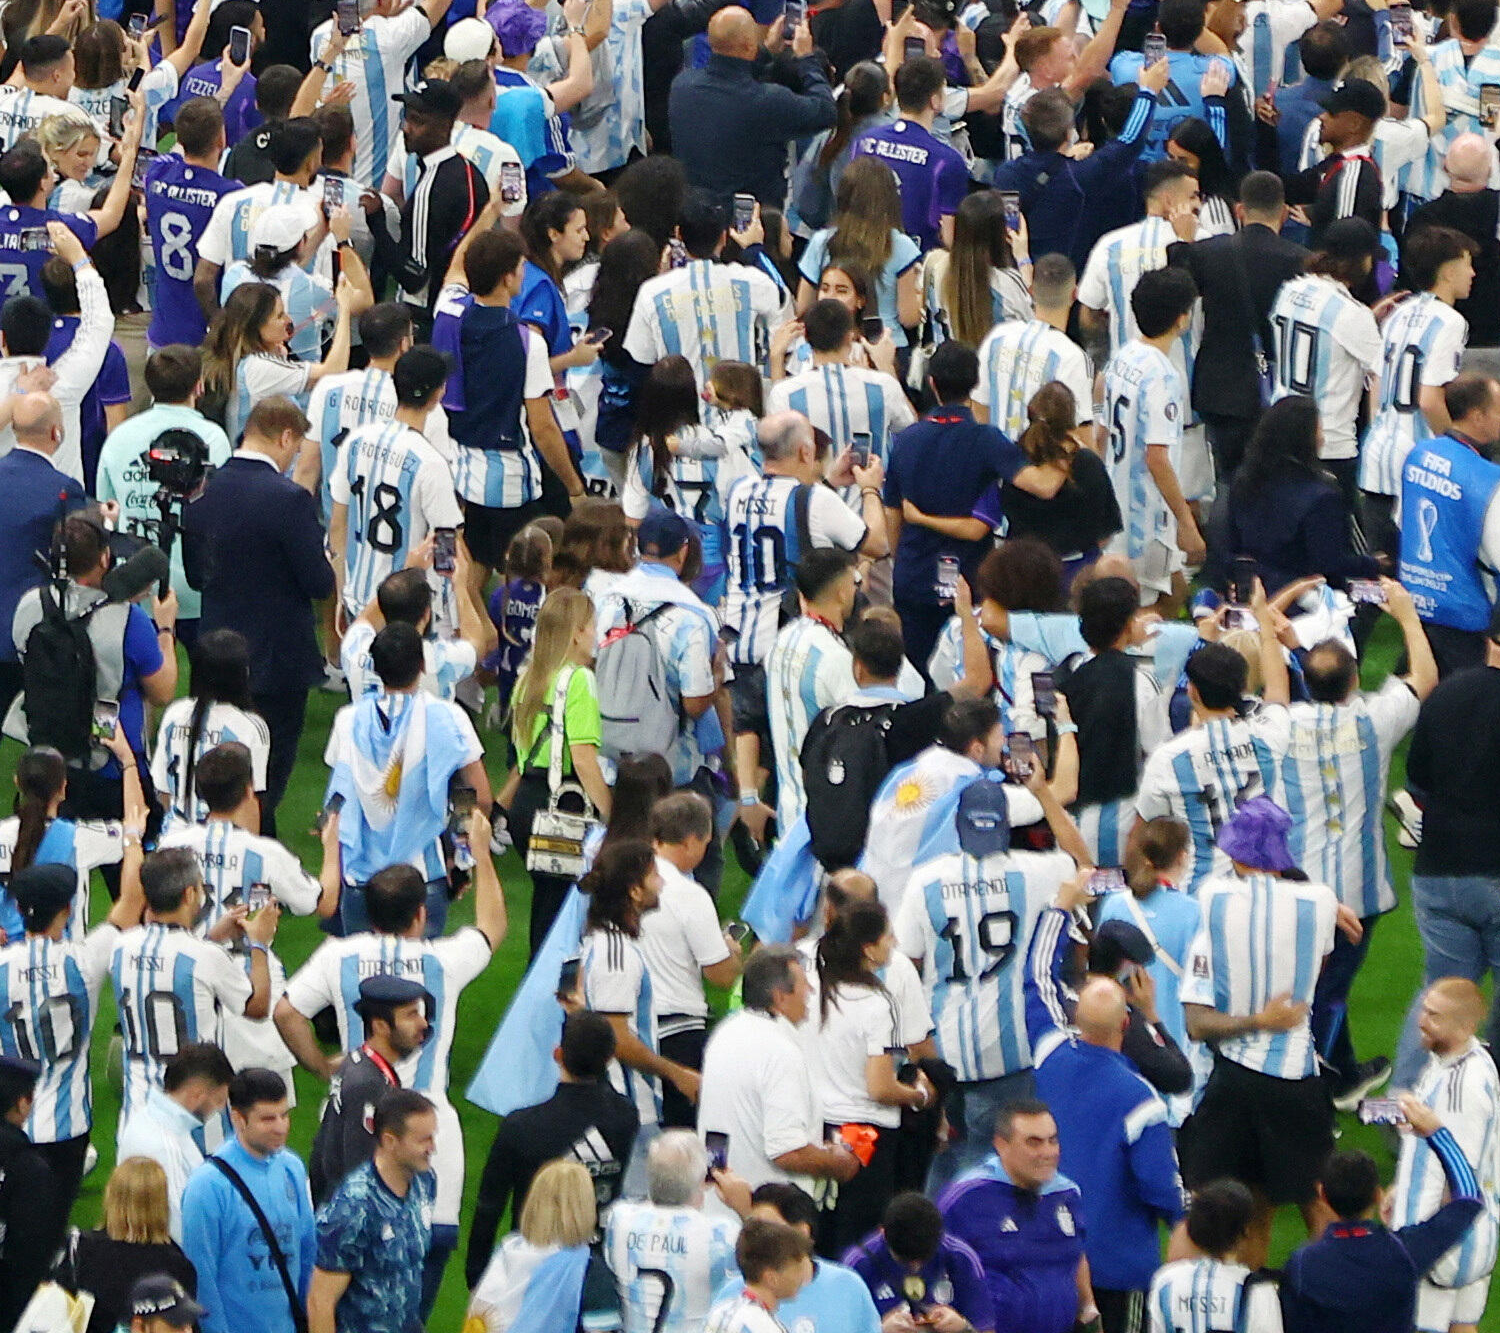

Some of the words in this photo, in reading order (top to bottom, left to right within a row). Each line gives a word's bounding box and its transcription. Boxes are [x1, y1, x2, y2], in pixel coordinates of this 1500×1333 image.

[880, 141, 928, 165] ALLISTER
[161, 214, 192, 281] 8
[1274, 316, 1320, 394] 10
[1407, 467, 1463, 500] STUDIOS
[1423, 453, 1451, 478] FIFA
[353, 476, 404, 553] 18
[736, 497, 776, 517] MESSI
[731, 525, 784, 592] 10
[940, 878, 1009, 898] OTAMENDI
[18, 964, 58, 982] MESSI
[940, 909, 1020, 984] 19
[4, 995, 84, 1061] 10
[126, 988, 186, 1057] 10
[626, 1233, 647, 1253] DE
[650, 1234, 689, 1254] PAUL
[636, 1266, 675, 1333] 7
